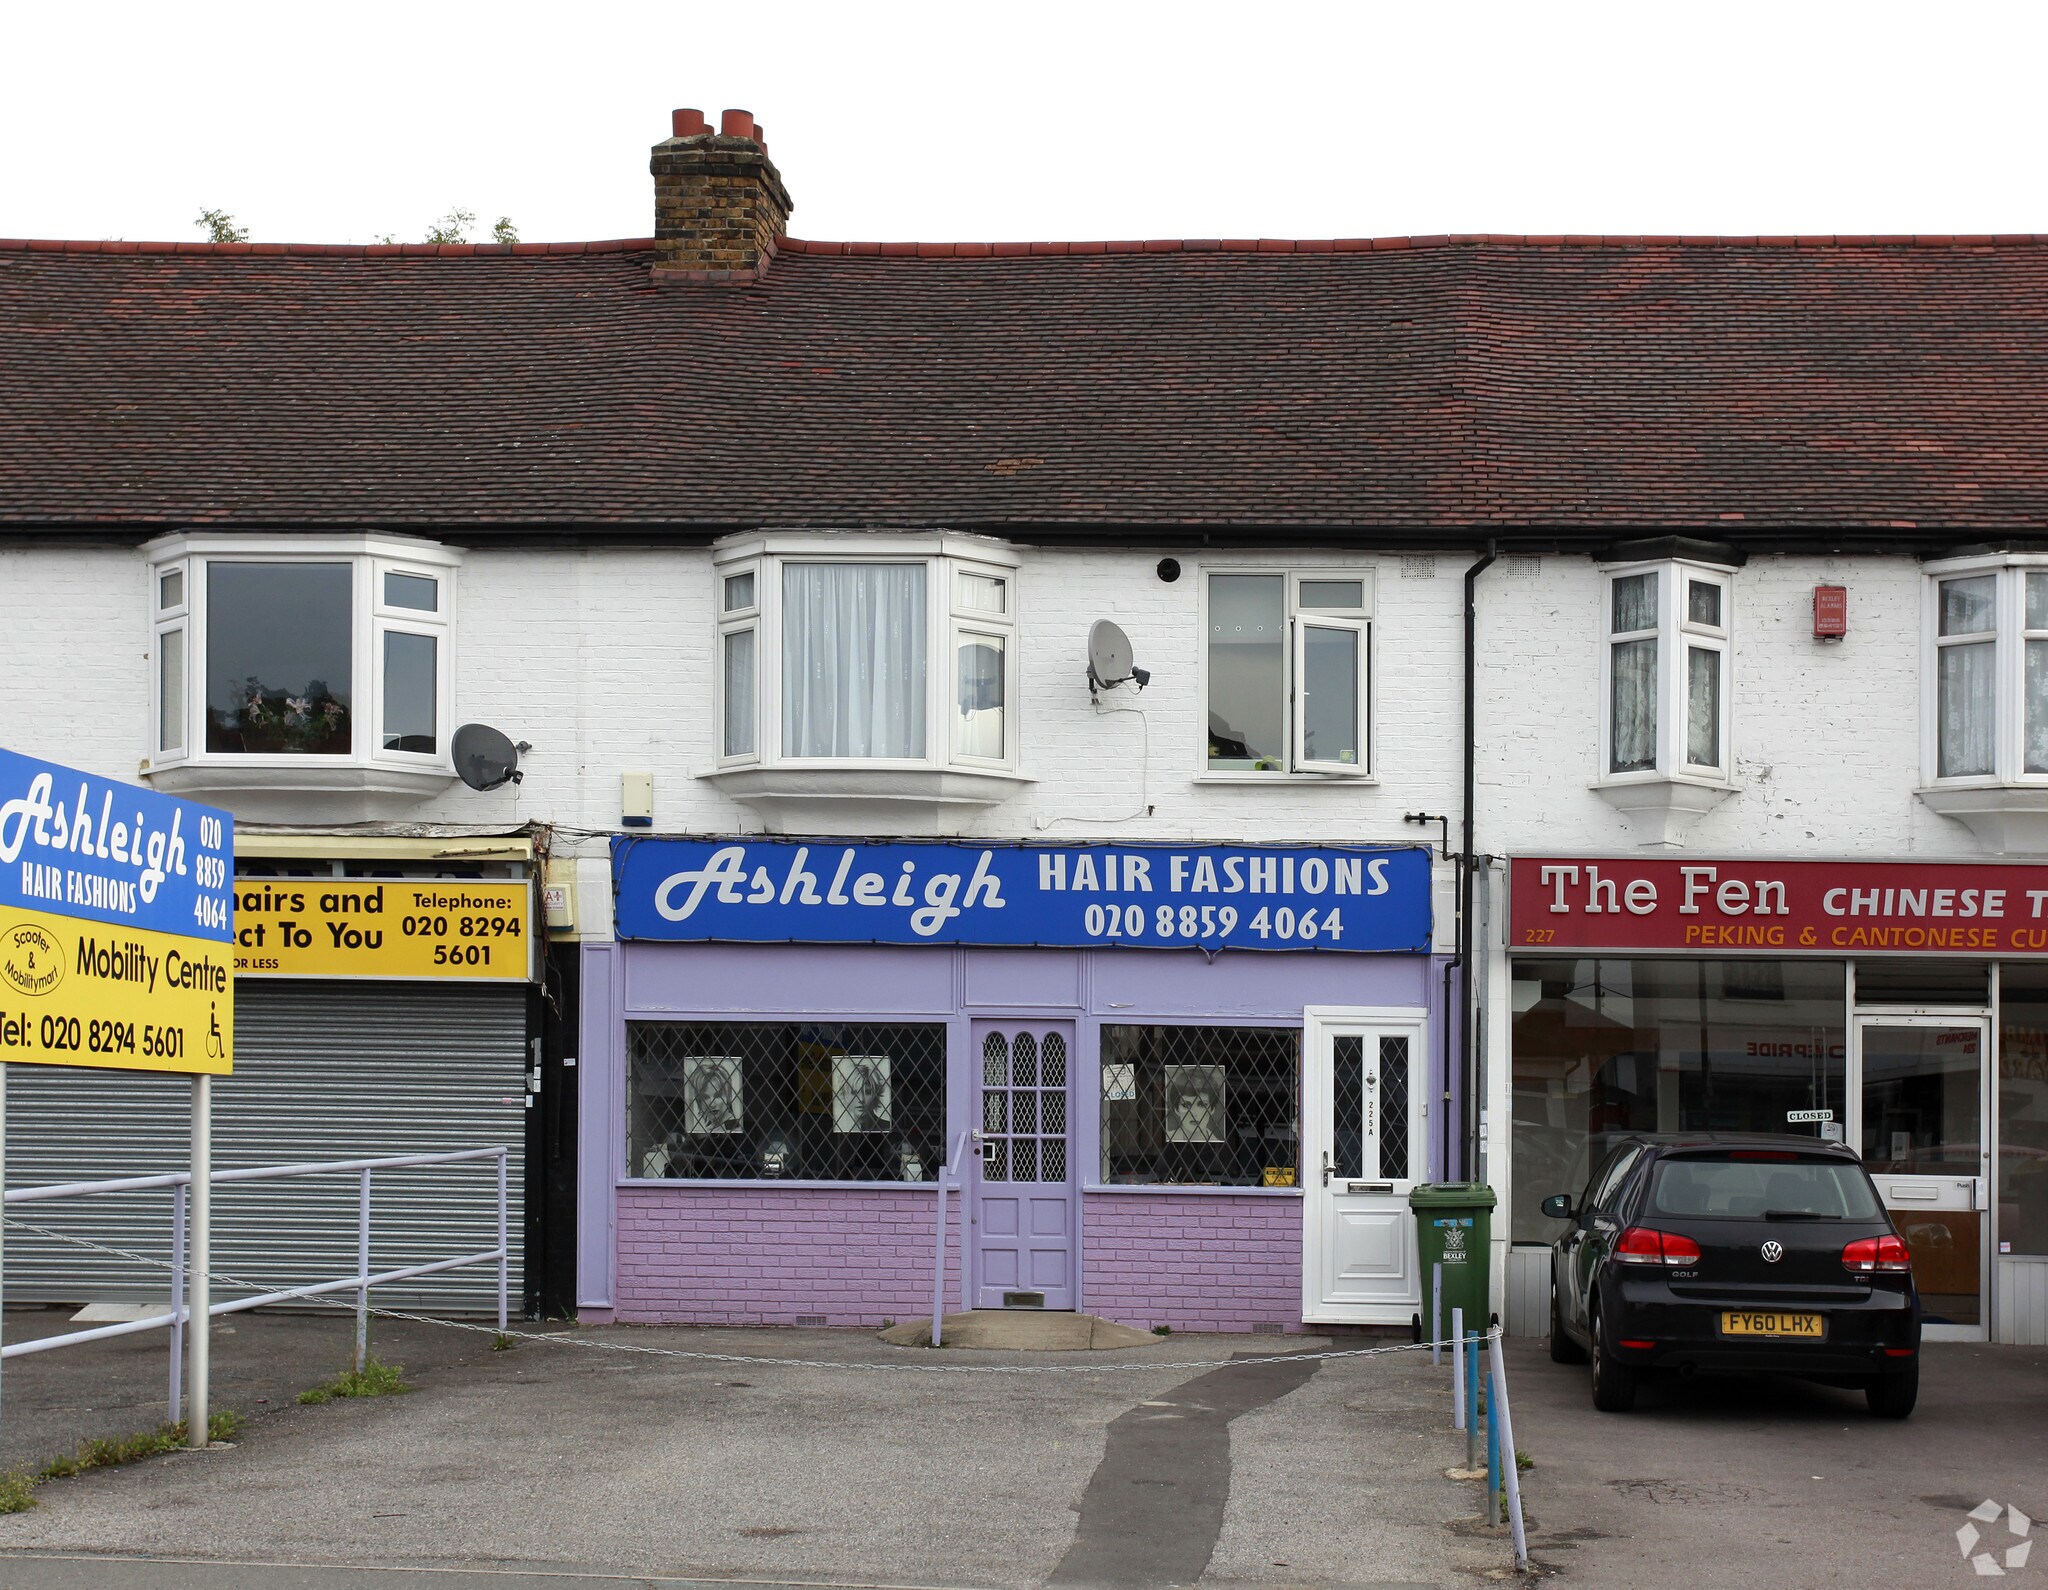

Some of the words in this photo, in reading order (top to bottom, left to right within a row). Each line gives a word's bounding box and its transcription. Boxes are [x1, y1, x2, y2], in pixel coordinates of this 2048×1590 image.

[0, 773, 187, 903] Ashleigh
[200, 815, 221, 850] 020
[196, 854, 225, 889] 8859
[1038, 853, 1153, 892] HAIR
[1169, 855, 1389, 896] FASHIONS
[22, 862, 62, 900] HAIR
[67, 870, 136, 914] FASHIONS
[319, 886, 383, 913] and
[412, 892, 512, 912] Telephone:
[654, 846, 1006, 936] Ashleigh
[1541, 865, 1658, 915] The
[1679, 866, 1790, 916] Fen
[1823, 887, 2007, 918] CHINESE
[2025, 890, 2048, 918] T
[194, 894, 227, 930] 4064
[402, 916, 447, 936] 020
[459, 917, 521, 937] 8294
[1084, 903, 1145, 937] 020
[1155, 904, 1239, 938] 8859
[1249, 906, 1344, 941] 4064
[14, 931, 50, 954] Scooter
[278, 921, 313, 947] To
[326, 922, 383, 949] You
[1525, 929, 1555, 943] 227
[1685, 925, 1785, 945] PEKING
[1799, 926, 1817, 945] &
[1831, 927, 1997, 948] CANTONESE
[28, 951, 35, 969] &
[77, 936, 159, 993] Mobility
[165, 950, 226, 993] Centre
[252, 958, 279, 968] LESS
[433, 945, 490, 965] 5601
[5, 959, 58, 993] Mobilitymart
[40, 1014, 81, 1050] 020
[89, 1019, 135, 1054] 8294
[143, 1025, 184, 1058] 5601
[1789, 1112, 1831, 1120] CLOSED
[1730, 1314, 1775, 1331] FY60
[1781, 1316, 1814, 1332] LHX
